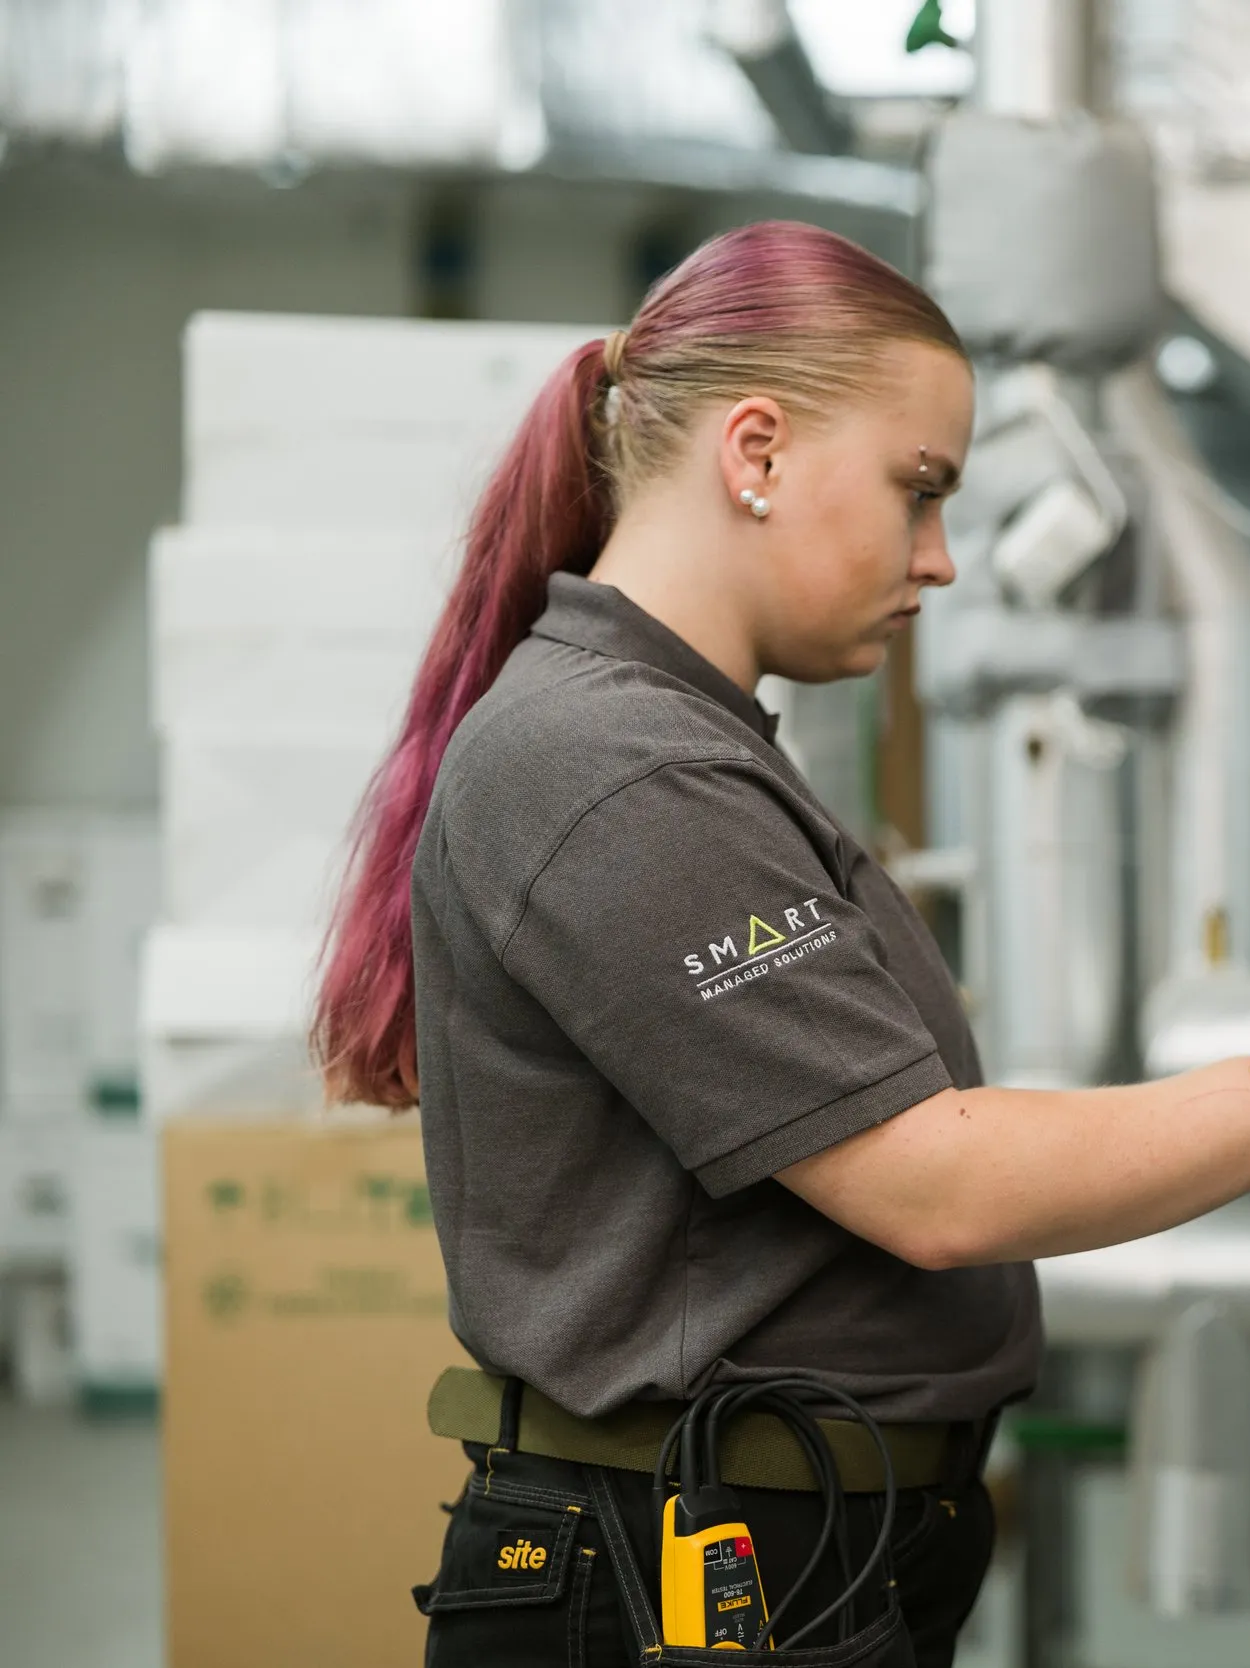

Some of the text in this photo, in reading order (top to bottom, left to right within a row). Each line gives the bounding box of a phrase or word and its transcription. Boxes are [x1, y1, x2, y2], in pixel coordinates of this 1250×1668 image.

[684, 897, 821, 975] SMART
[700, 931, 837, 1001] MANAGED SOLUTIONS
[497, 1538, 547, 1569] site
[705, 1548, 718, 1556] COM
[729, 1556, 738, 1564] CAT
[720, 1598, 748, 1609] FLUKE
[714, 1627, 728, 1638] OFF
